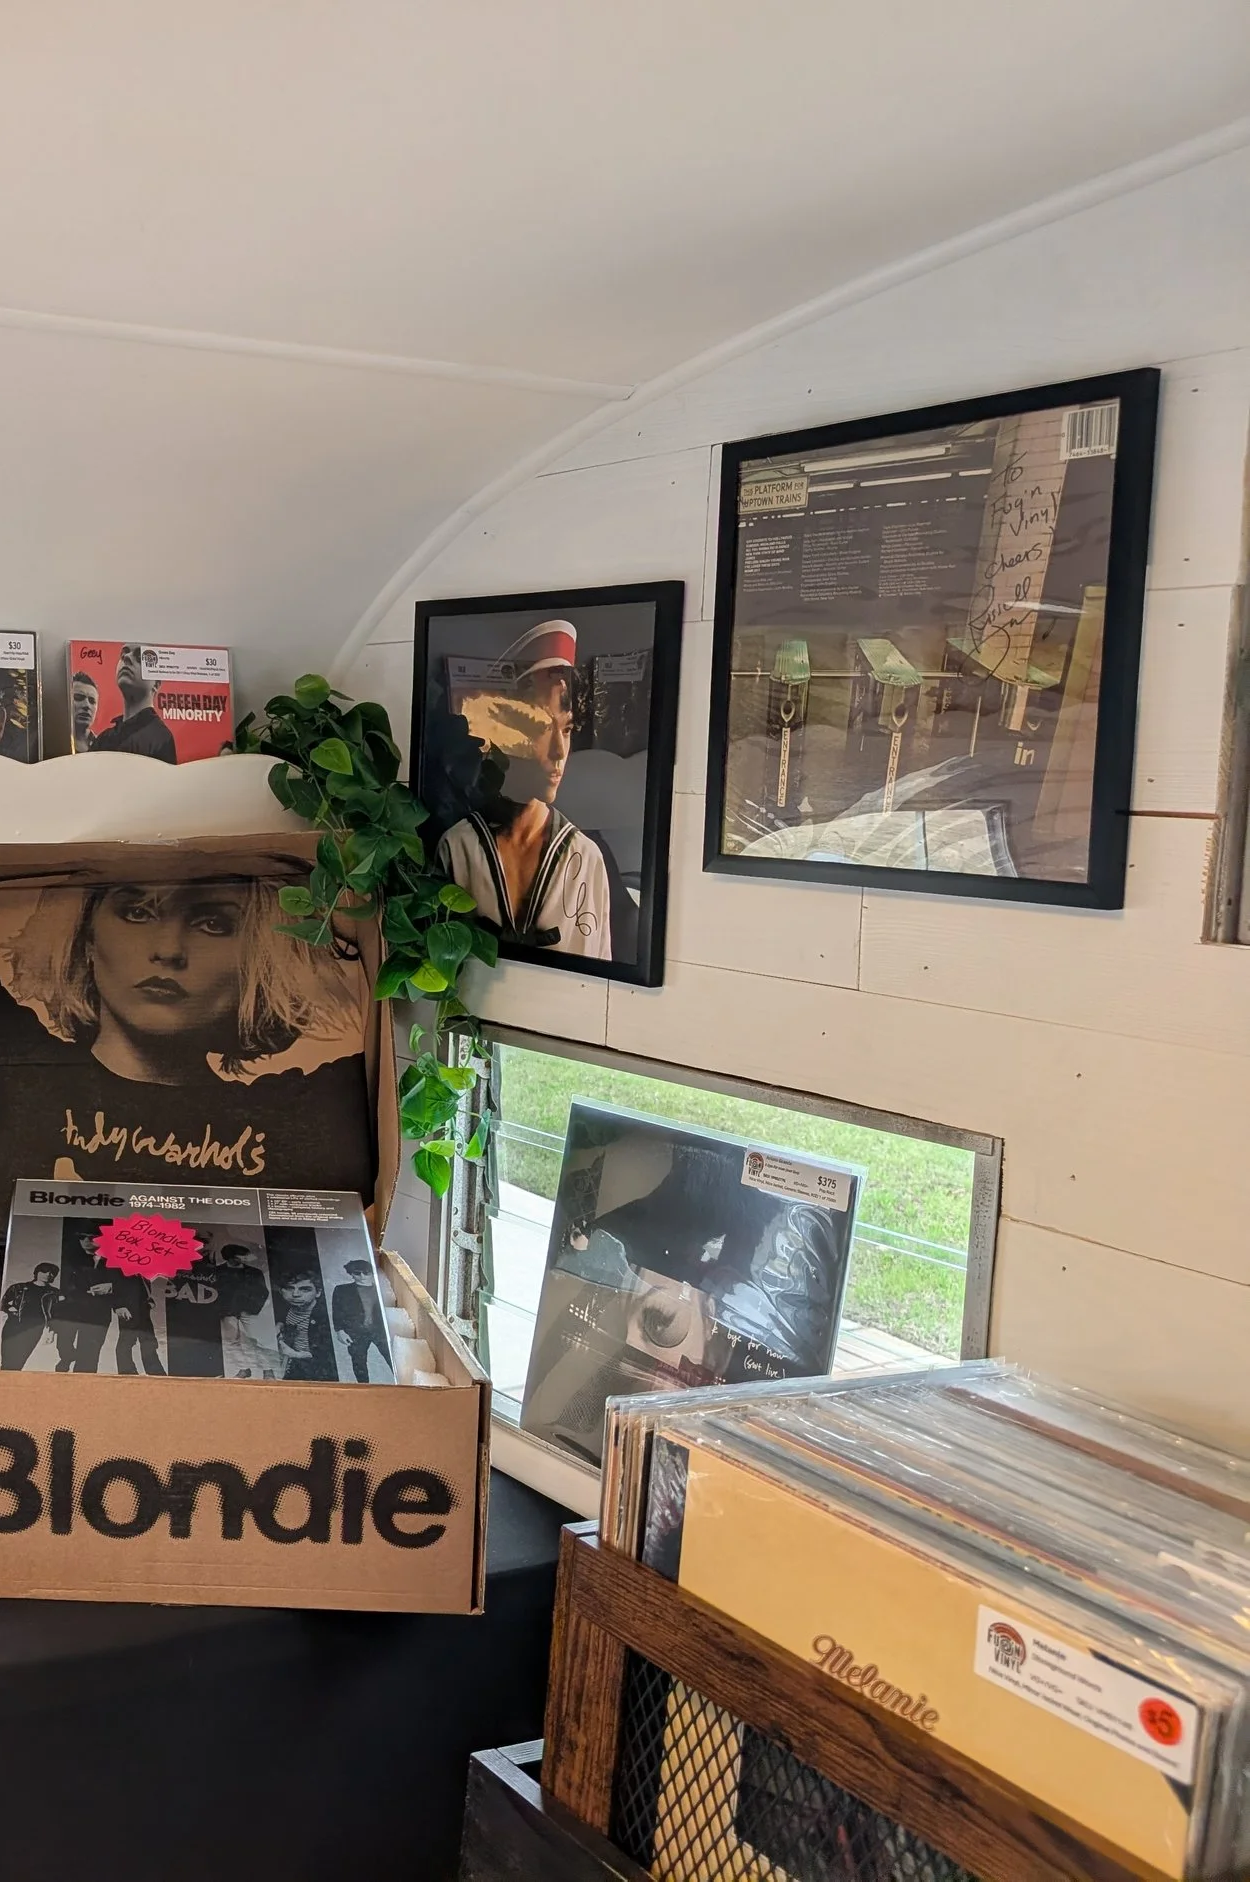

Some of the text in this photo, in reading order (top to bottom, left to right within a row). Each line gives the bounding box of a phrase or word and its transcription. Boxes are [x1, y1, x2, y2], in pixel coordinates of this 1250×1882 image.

[992, 451, 1027, 487] To
[754, 481, 792, 494] PLATFORM
[776, 493, 802, 504] TRAINS
[8, 641, 22, 650] $30
[206, 658, 216, 666] $30
[158, 692, 228, 712] GREEN DAY
[162, 708, 223, 722] MINORITY
[778, 730, 789, 806] ENTRANCE
[884, 735, 900, 811] ENTRANCE
[817, 1176, 837, 1189] $375
[30, 1191, 124, 1208] Blondie
[129, 1195, 185, 1204] AGAINST
[215, 1198, 250, 1206] ODDS
[114, 1230, 174, 1257] Box Set
[130, 1219, 190, 1250] Blondie
[116, 1246, 151, 1266] $300
[163, 1281, 218, 1304] BAD
[728, 1329, 742, 1348] bye
[748, 1334, 760, 1350] for
[766, 1348, 789, 1360] now
[994, 1647, 1022, 1674] VINYL
[810, 1634, 940, 1730] Melanie
[1148, 1708, 1174, 1738] $5
